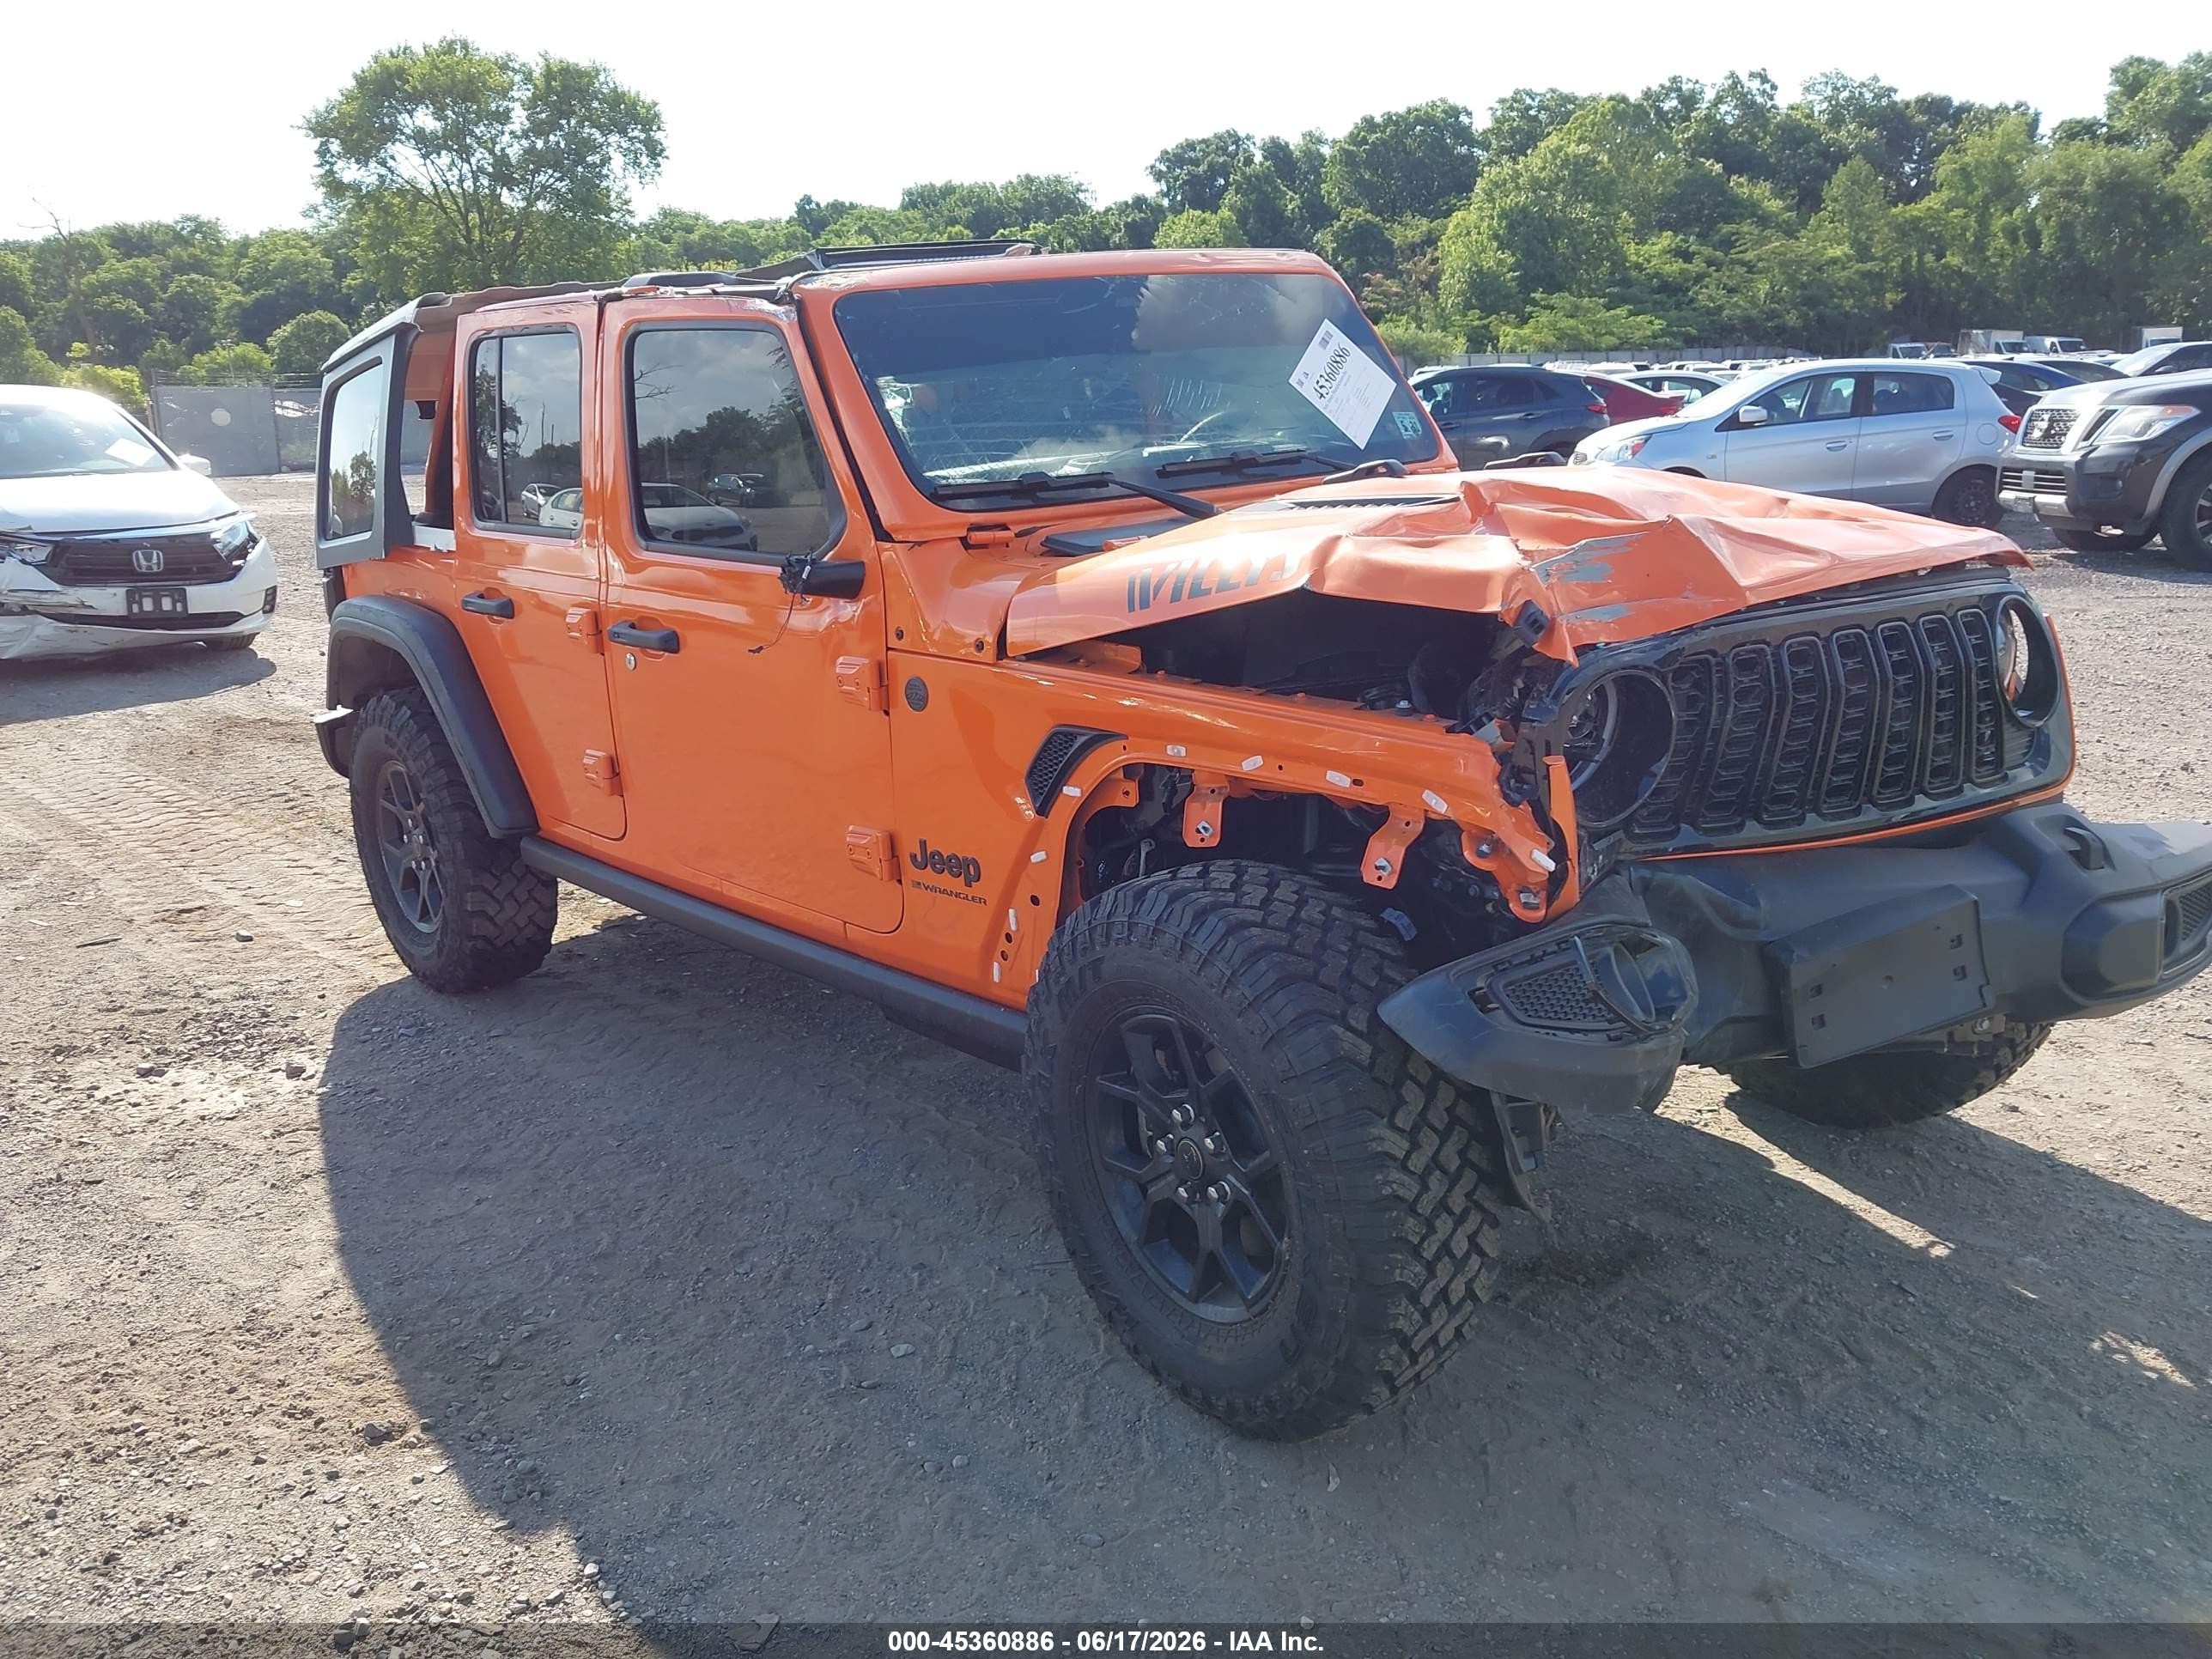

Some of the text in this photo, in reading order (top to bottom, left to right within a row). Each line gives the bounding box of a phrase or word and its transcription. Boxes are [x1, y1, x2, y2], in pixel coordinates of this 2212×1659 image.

[1311, 343, 1352, 400] 45360886
[909, 838, 981, 888] Jeep
[921, 882, 988, 906] WRANGLER
